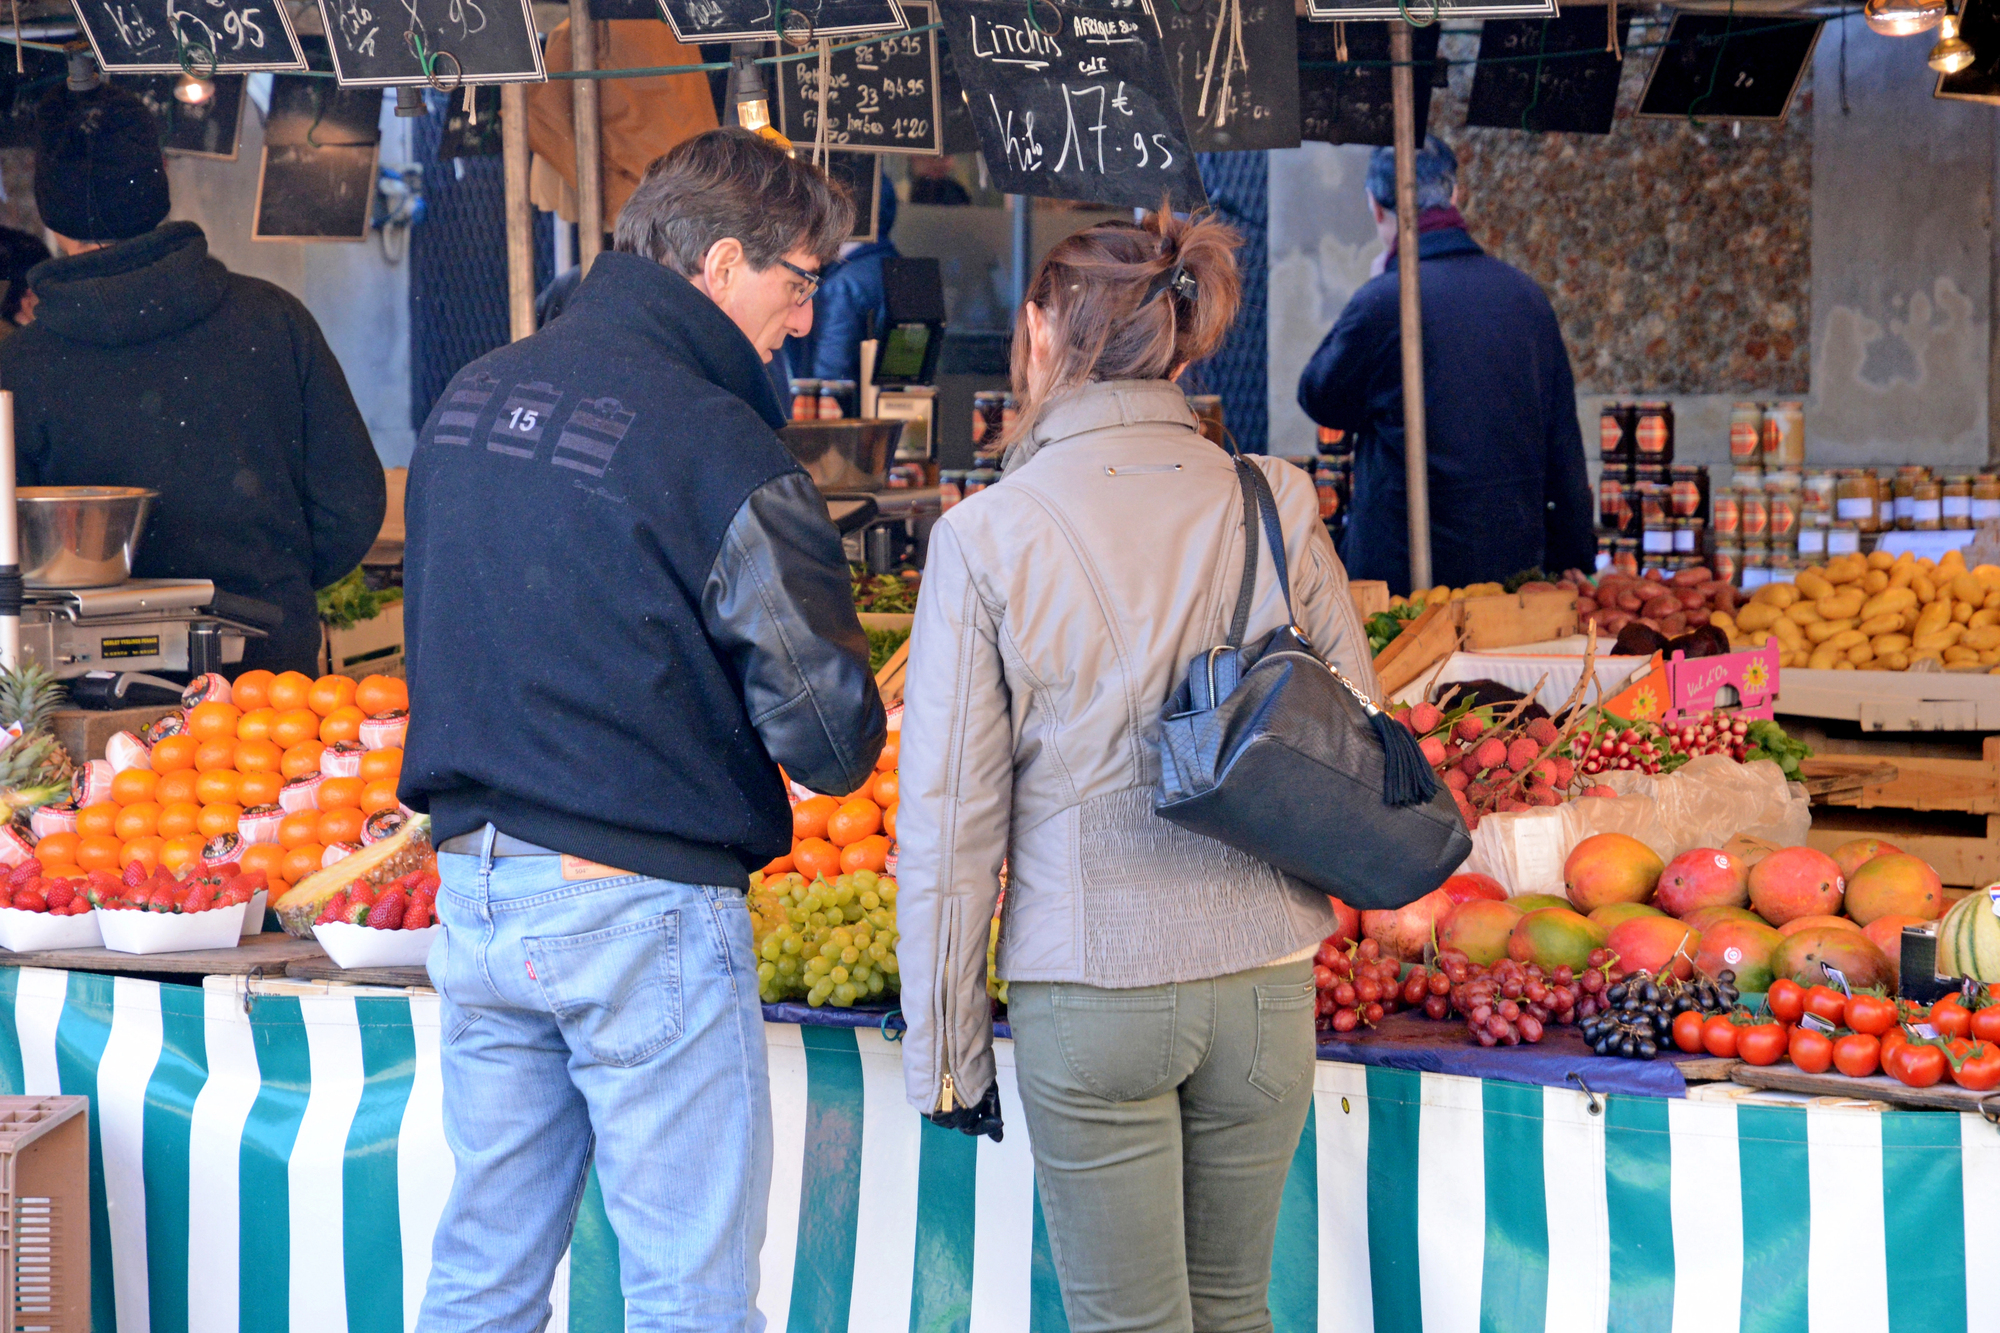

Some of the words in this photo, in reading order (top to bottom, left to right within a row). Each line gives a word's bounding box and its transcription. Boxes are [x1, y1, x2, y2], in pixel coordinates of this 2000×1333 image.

[989, 93, 1043, 171] Kilo
[509, 406, 539, 432] 15
[1687, 674, 1705, 698] Val
